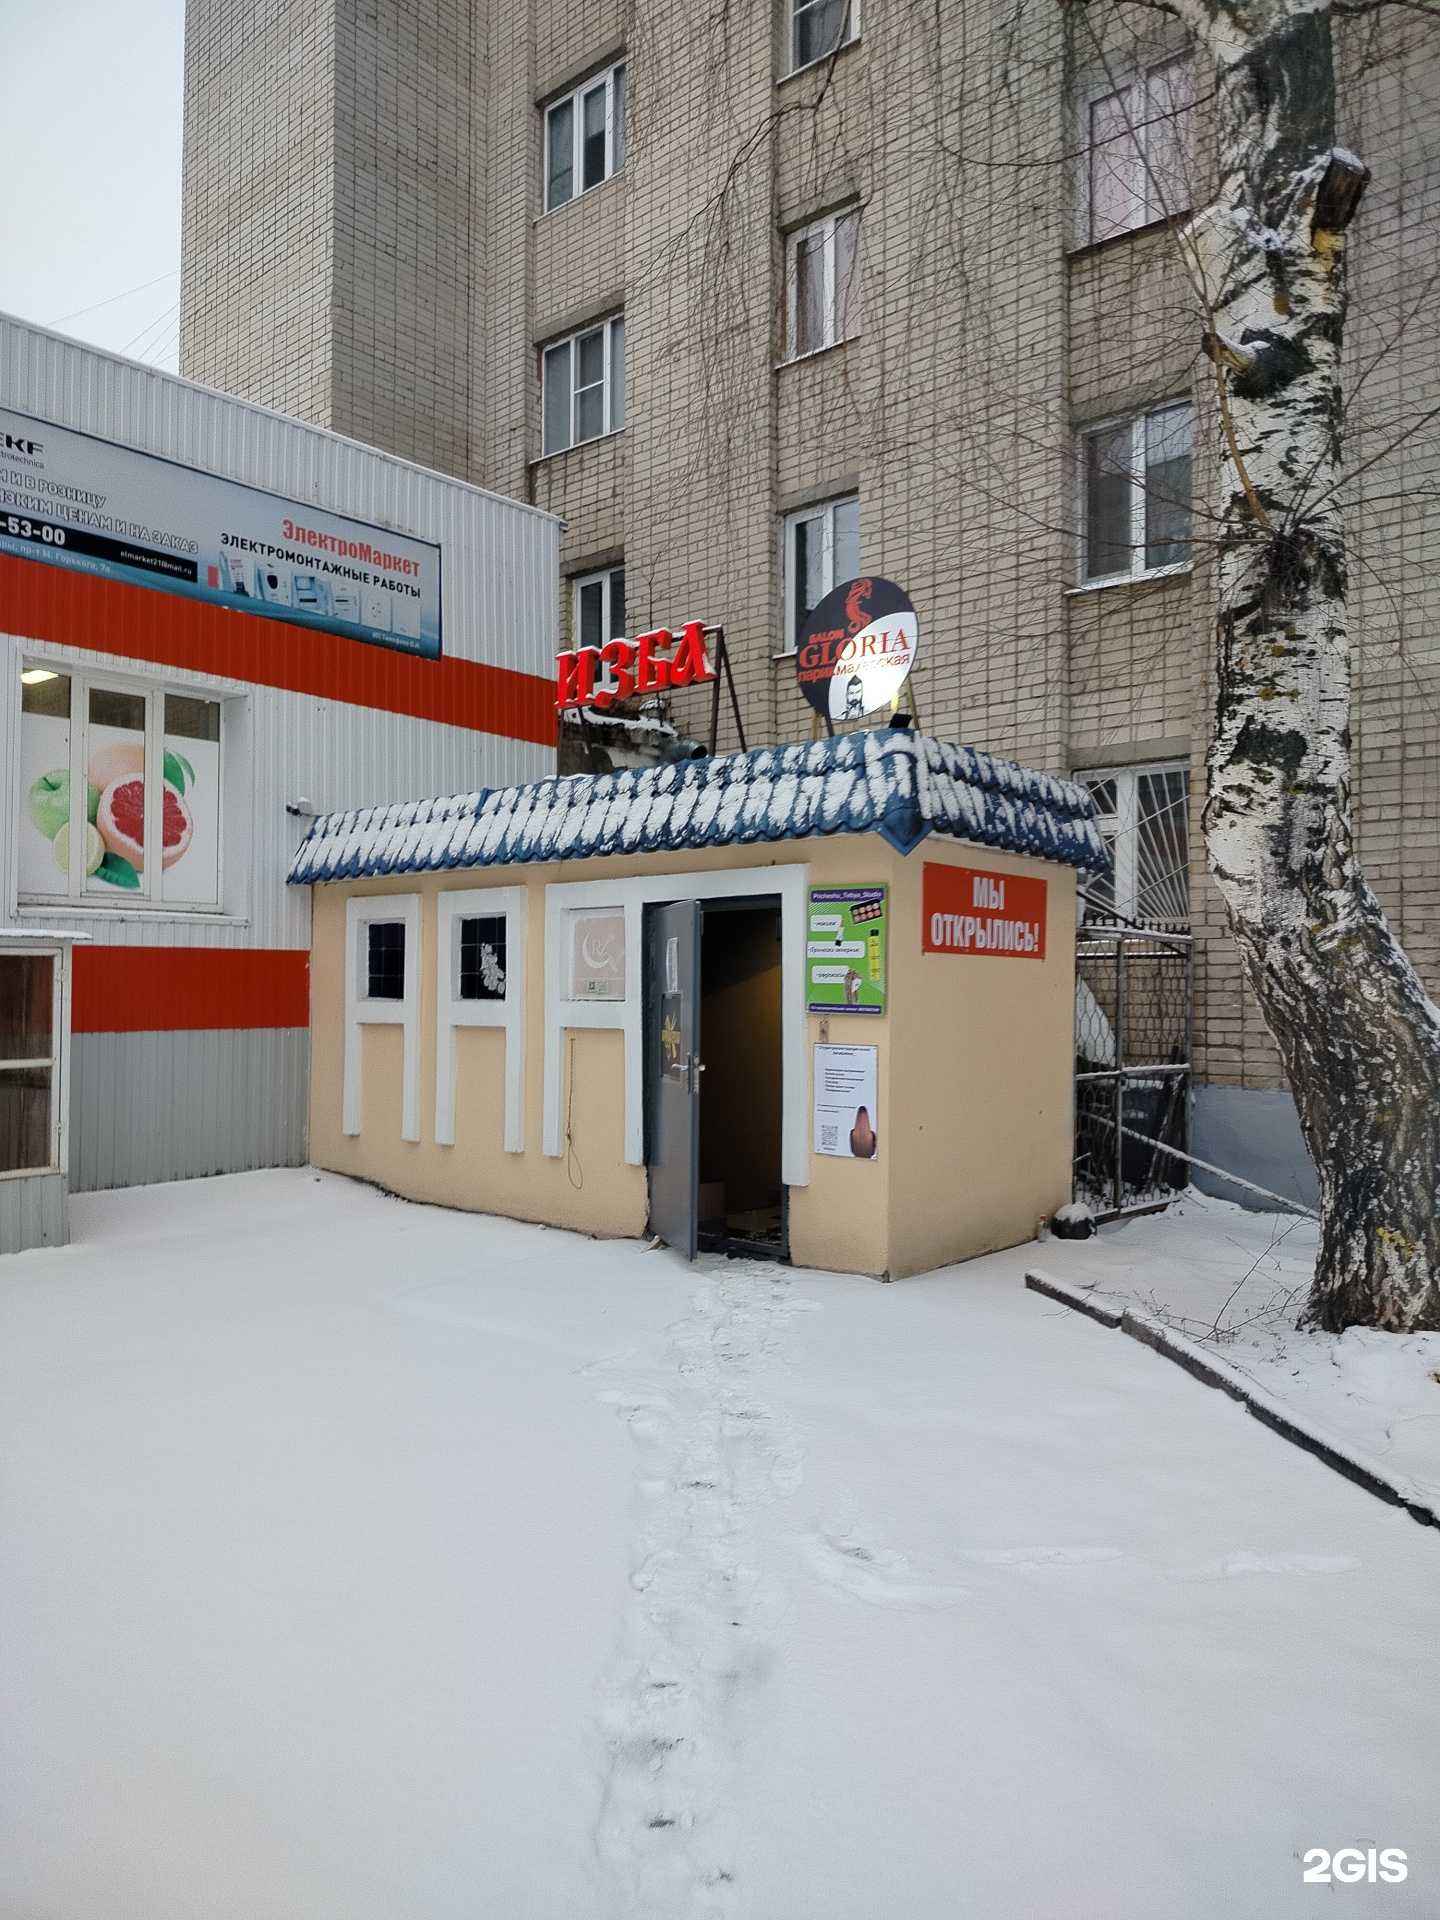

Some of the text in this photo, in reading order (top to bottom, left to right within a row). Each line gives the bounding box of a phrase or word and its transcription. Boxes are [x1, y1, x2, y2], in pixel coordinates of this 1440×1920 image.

[25, 474, 36, 489] В
[38, 478, 107, 509] РОЗНИЦУ
[56, 501, 112, 533] ЦЕНАМ
[115, 519, 127, 535] И
[129, 522, 151, 543] НА
[151, 529, 199, 554] ЗАКАЗ
[282, 518, 421, 577] ЭлектроМаркет
[220, 532, 421, 599] ЭЛЕКТРОМОНТАЖНЫЕ РАБОТЫ
[553, 619, 719, 709] ИЗБА
[799, 627, 912, 669] GLORIA
[973, 876, 1005, 910] МЫ
[931, 912, 1040, 952] ОТКРЫЛИСЬ!
